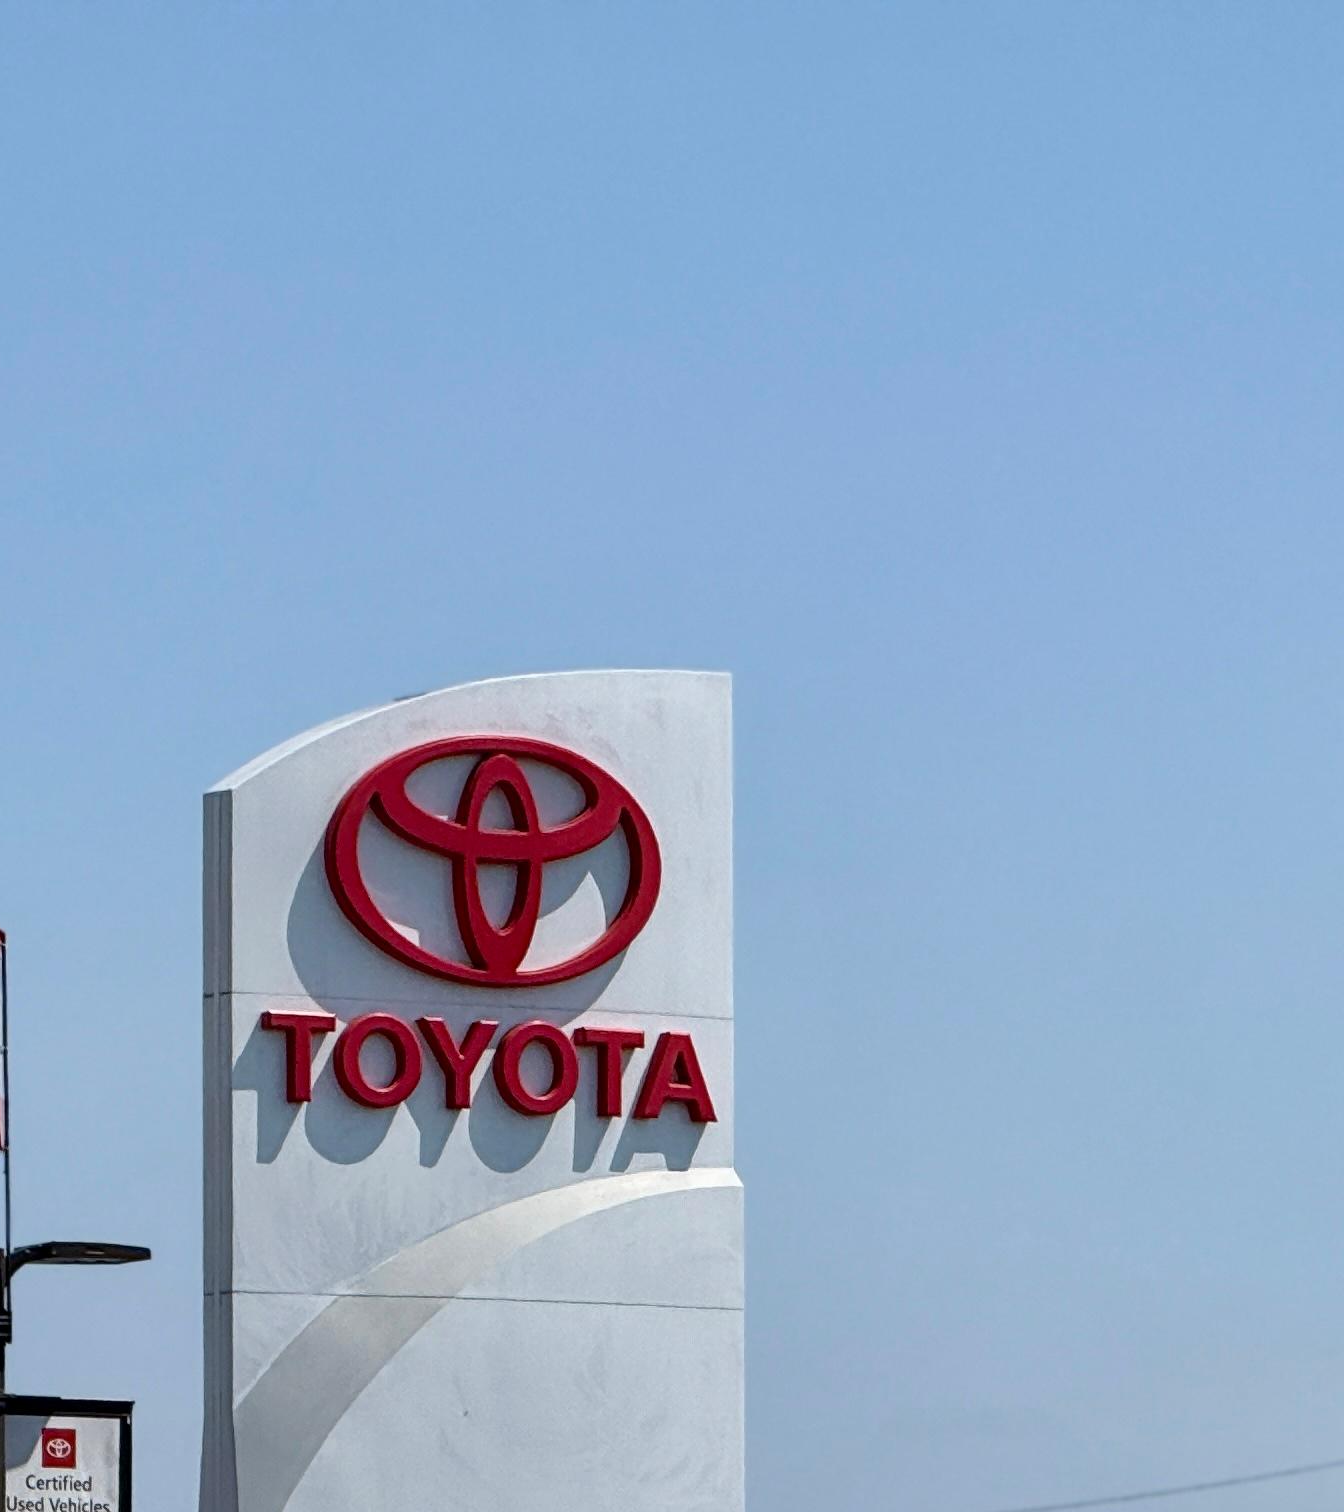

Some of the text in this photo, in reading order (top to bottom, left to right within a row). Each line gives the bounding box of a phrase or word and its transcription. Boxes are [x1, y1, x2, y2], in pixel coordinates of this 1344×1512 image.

[261, 1010, 718, 1122] TOYOTA
[26, 1474, 92, 1491] Certified
[6, 1496, 44, 1512] Used
